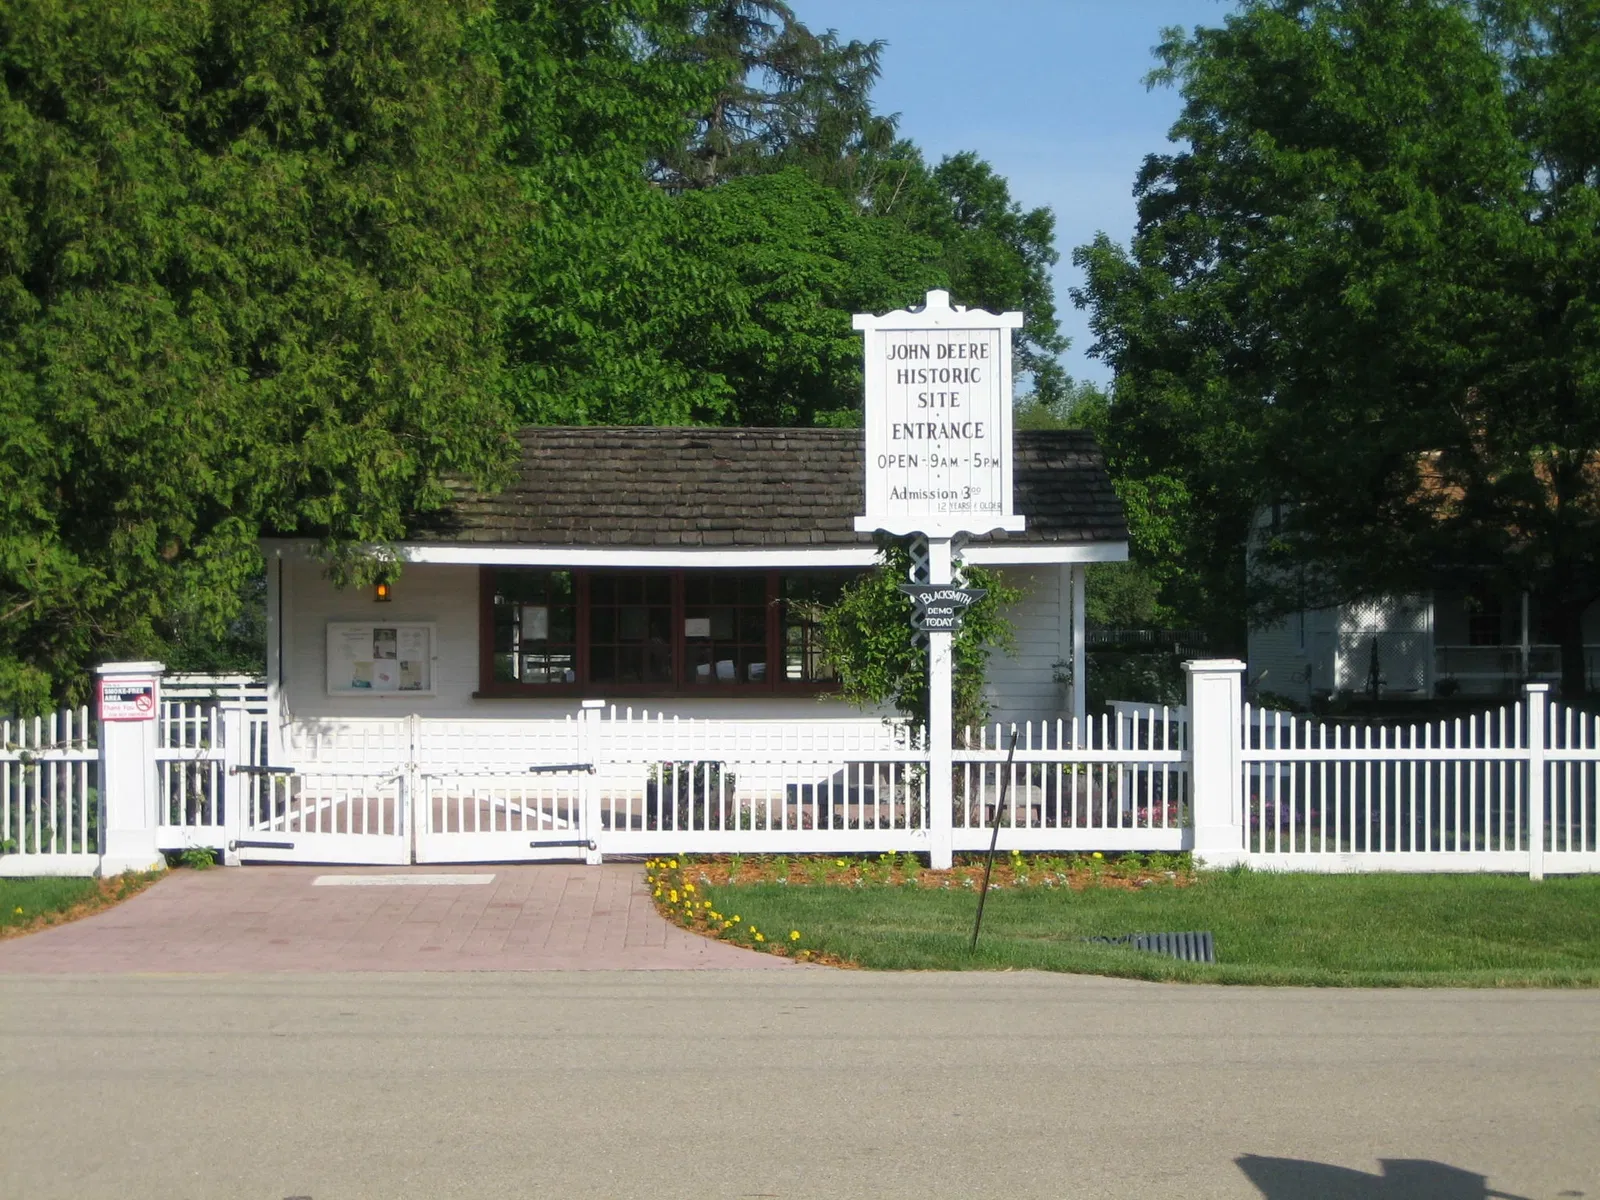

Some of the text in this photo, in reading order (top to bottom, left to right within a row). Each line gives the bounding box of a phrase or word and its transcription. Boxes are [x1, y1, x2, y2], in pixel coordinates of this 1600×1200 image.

[887, 343, 989, 360] JOHN DEERE
[897, 368, 981, 384] HISTORIC
[917, 392, 960, 408] SITE
[892, 422, 984, 440] ENTRANCE
[878, 454, 918, 469] OPEN
[890, 485, 958, 500] Admission
[938, 502, 947, 511] 12
[950, 502, 971, 510] YEARS
[979, 502, 1001, 510] OLDER
[920, 590, 972, 605] BLACKSMITH
[927, 607, 953, 615] DEMO
[925, 618, 954, 627] TODAY
